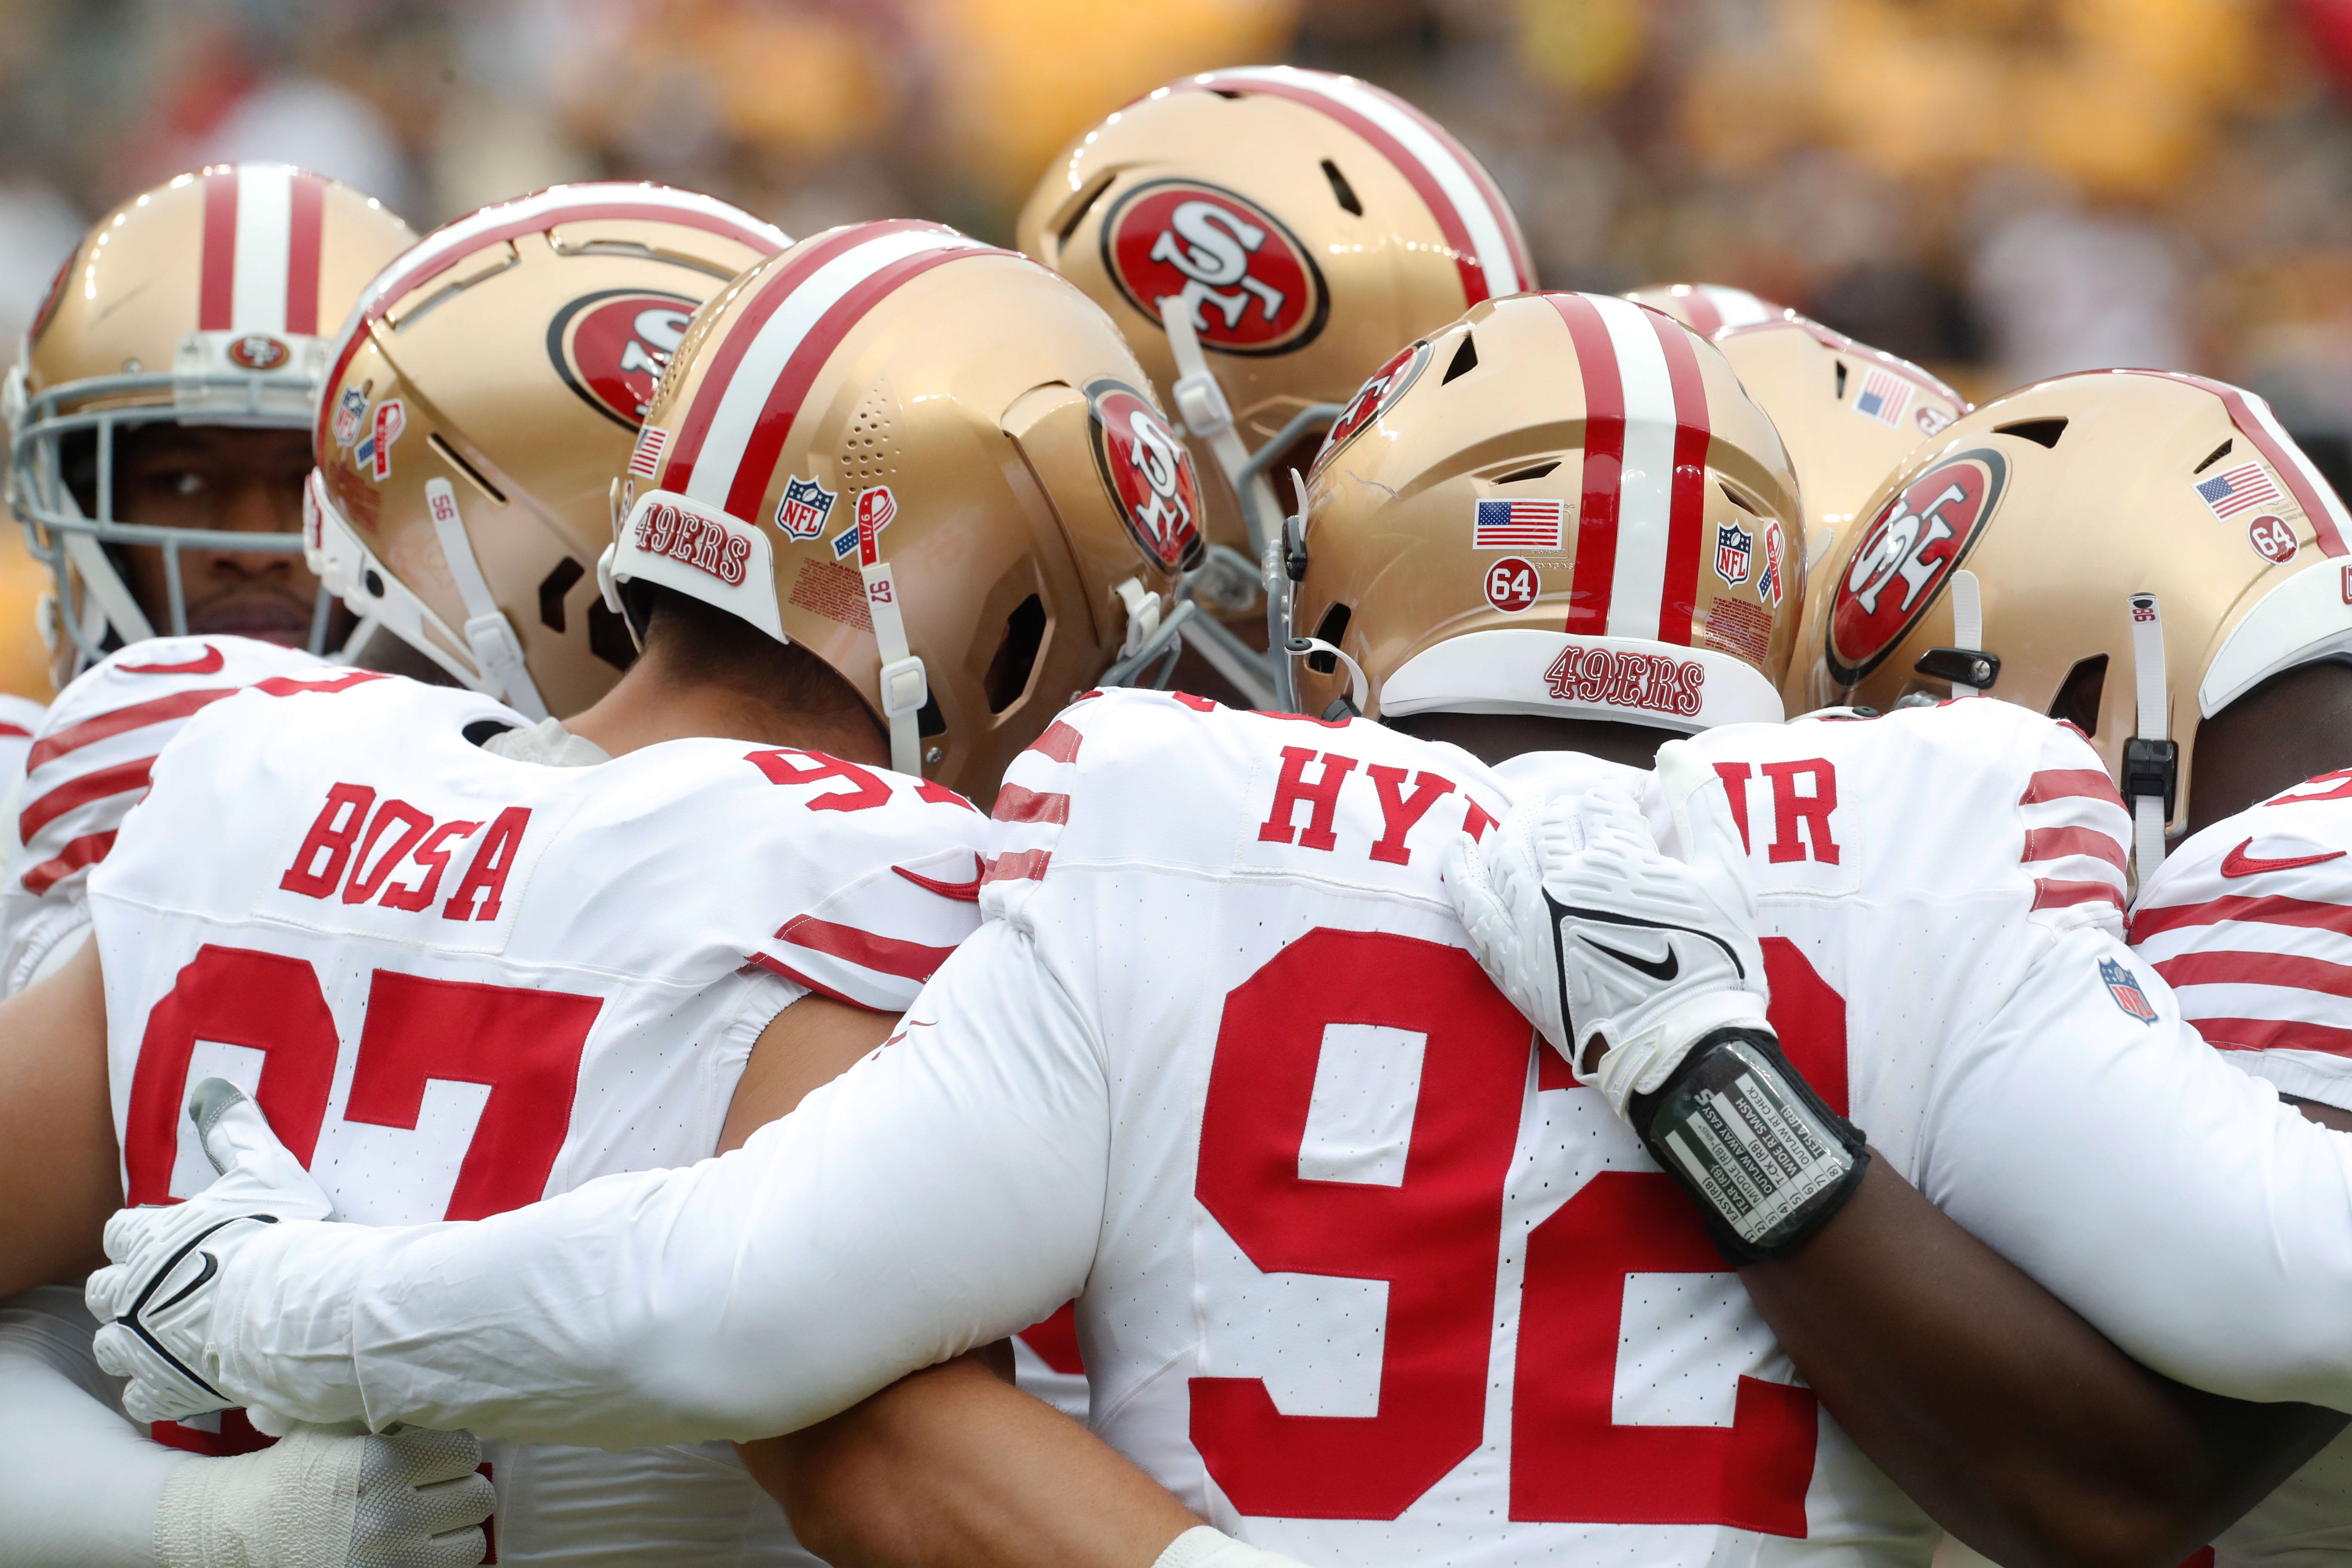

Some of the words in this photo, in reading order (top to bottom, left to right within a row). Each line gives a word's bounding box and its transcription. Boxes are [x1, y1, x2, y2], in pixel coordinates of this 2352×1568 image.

[431, 493, 455, 522] 56
[782, 502, 819, 532] NFL
[861, 514, 872, 542] 9/11
[2251, 521, 2294, 556] 64
[634, 502, 751, 586] 49ERS
[830, 561, 861, 576] WARNI
[1719, 548, 1746, 577] NFL
[1769, 550, 1778, 577] 9/11
[870, 581, 891, 603] 97
[1491, 569, 1531, 601] 64
[1732, 597, 1762, 611] WARNING
[1544, 645, 1705, 717] 49ERS
[279, 782, 532, 922] BOSA
[2112, 986, 2154, 1018] NFL
[1746, 1087, 1770, 1114] CHECK
[1702, 1107, 1722, 1128] EASY
[1736, 1098, 1766, 1133] SMASH
[1768, 1116, 1780, 1127] RT
[1779, 1104, 1801, 1128] (RB)
[1712, 1143, 1732, 1165] (RB)
[1719, 1129, 1743, 1155] AWAY
[1748, 1139, 1768, 1161] (RB)
[1762, 1134, 1776, 1148] RT
[1777, 1128, 1809, 1164] OUTLAW
[1797, 1126, 1822, 1156] TESLA
[1773, 1146, 1796, 1175] WIDE
[1827, 1165, 1838, 1176] 8)
[1711, 1165, 1730, 1187] (RB)
[1728, 1165, 1760, 1203] MIDDLE
[1740, 1156, 1772, 1193] OUTLAW
[1802, 1182, 1813, 1194] 6)
[1814, 1174, 1825, 1186] 7)
[1727, 1186, 1748, 1213] TEAR
[1777, 1202, 1787, 1213] 4)
[1789, 1192, 1801, 1205] 5)
[1755, 1221, 1765, 1233] 2)
[1765, 1212, 1776, 1224] 3)
[1189, 927, 1848, 1538] 92
[1744, 1230, 1754, 1243] 1)
